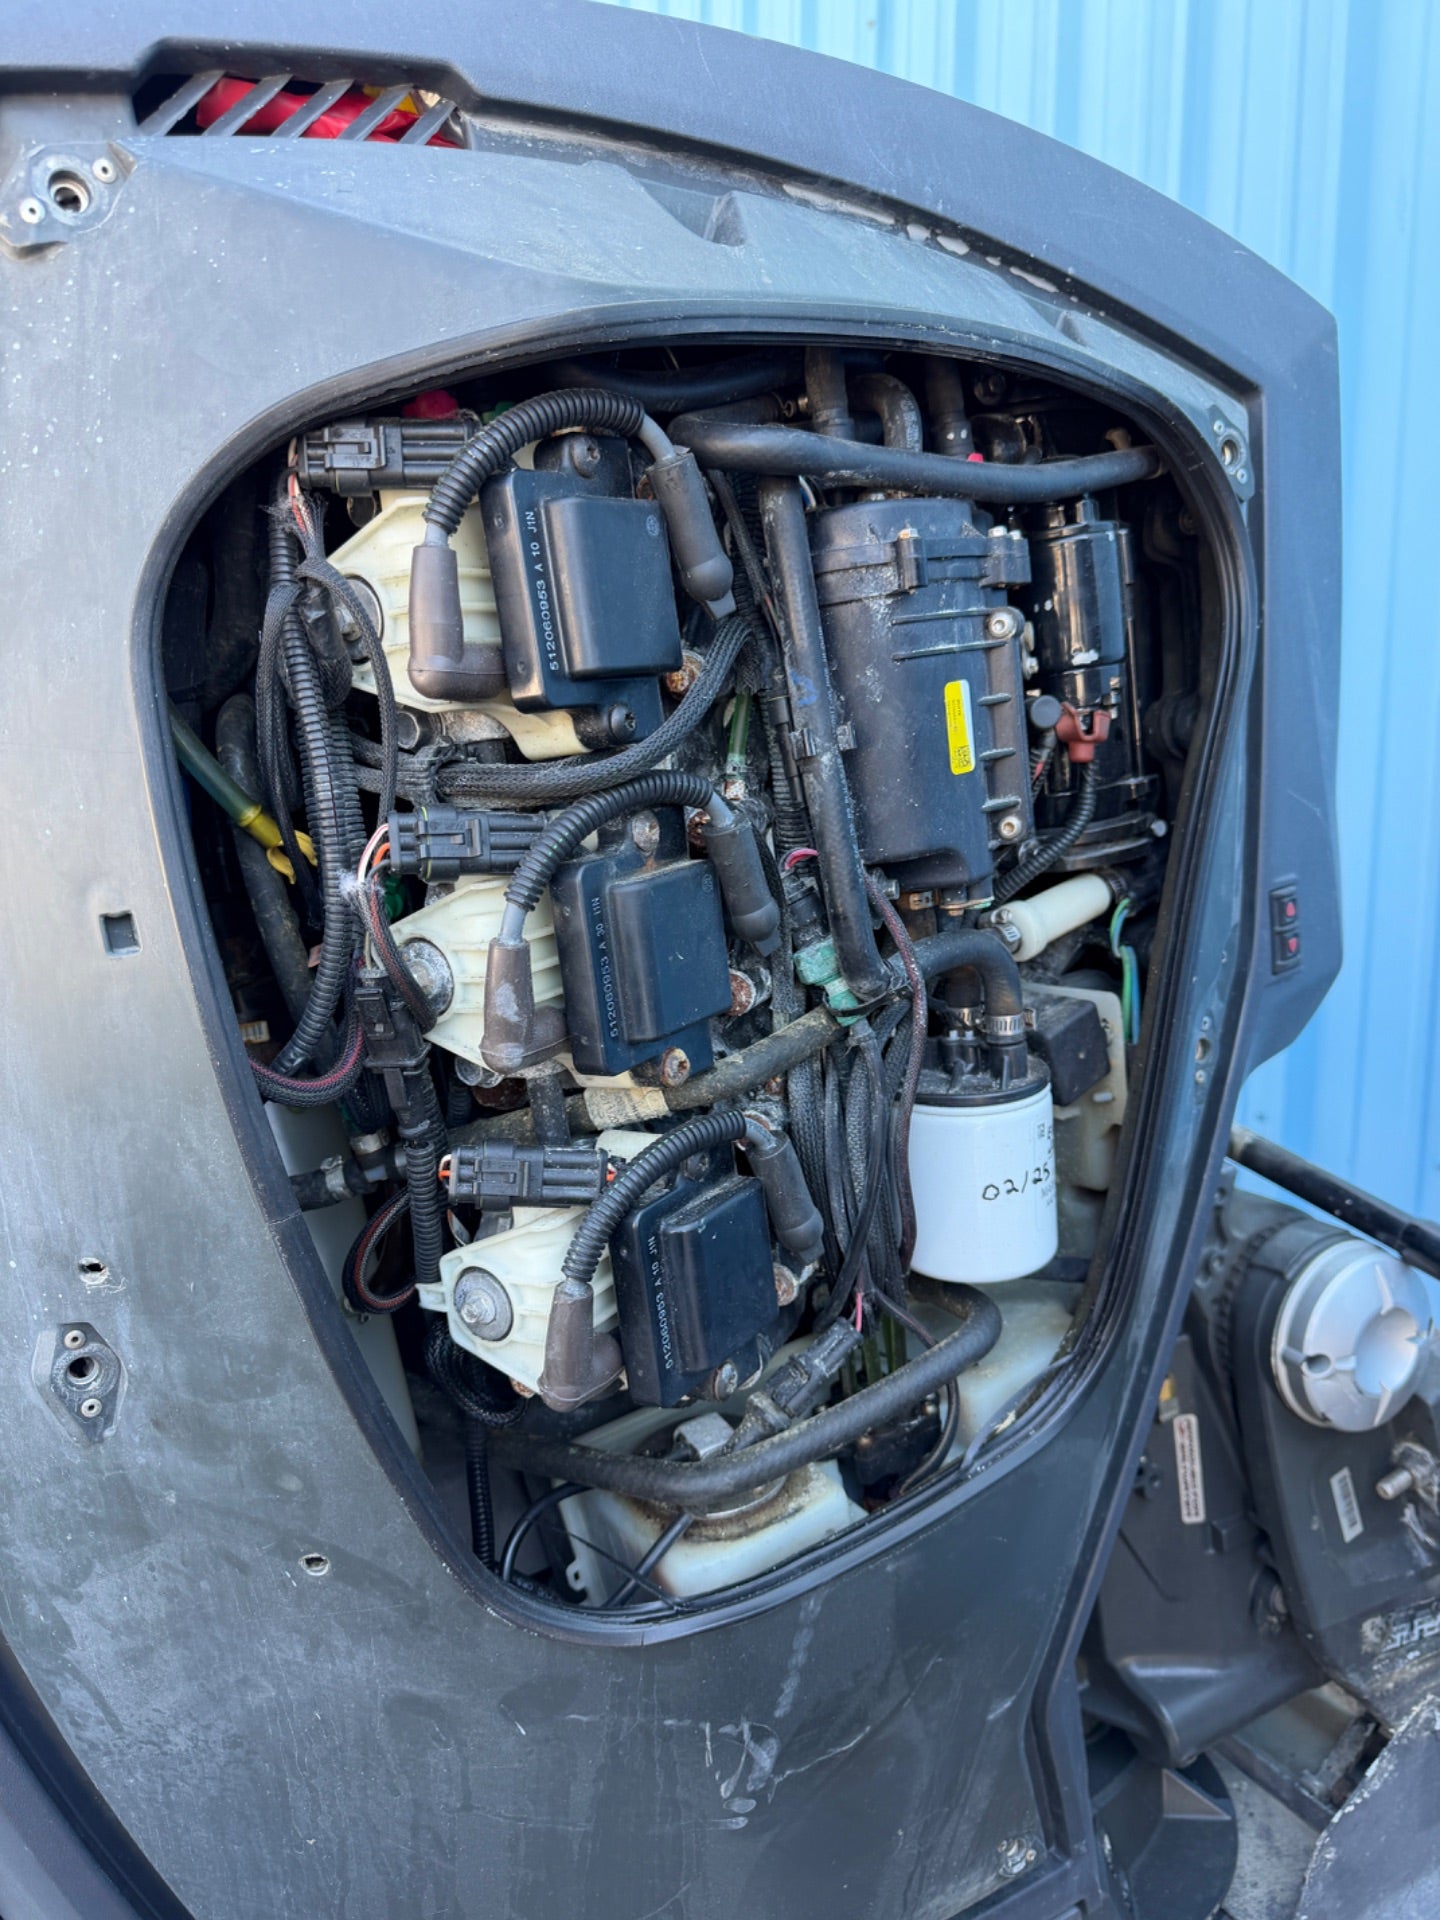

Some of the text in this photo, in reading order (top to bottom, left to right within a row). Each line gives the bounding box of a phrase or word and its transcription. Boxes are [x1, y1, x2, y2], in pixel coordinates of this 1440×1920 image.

[531, 541, 541, 557] 10
[534, 563, 544, 572] A
[536, 579, 560, 671] 512060953
[598, 941, 607, 950] A
[982, 1162, 1051, 1200] 02/25
